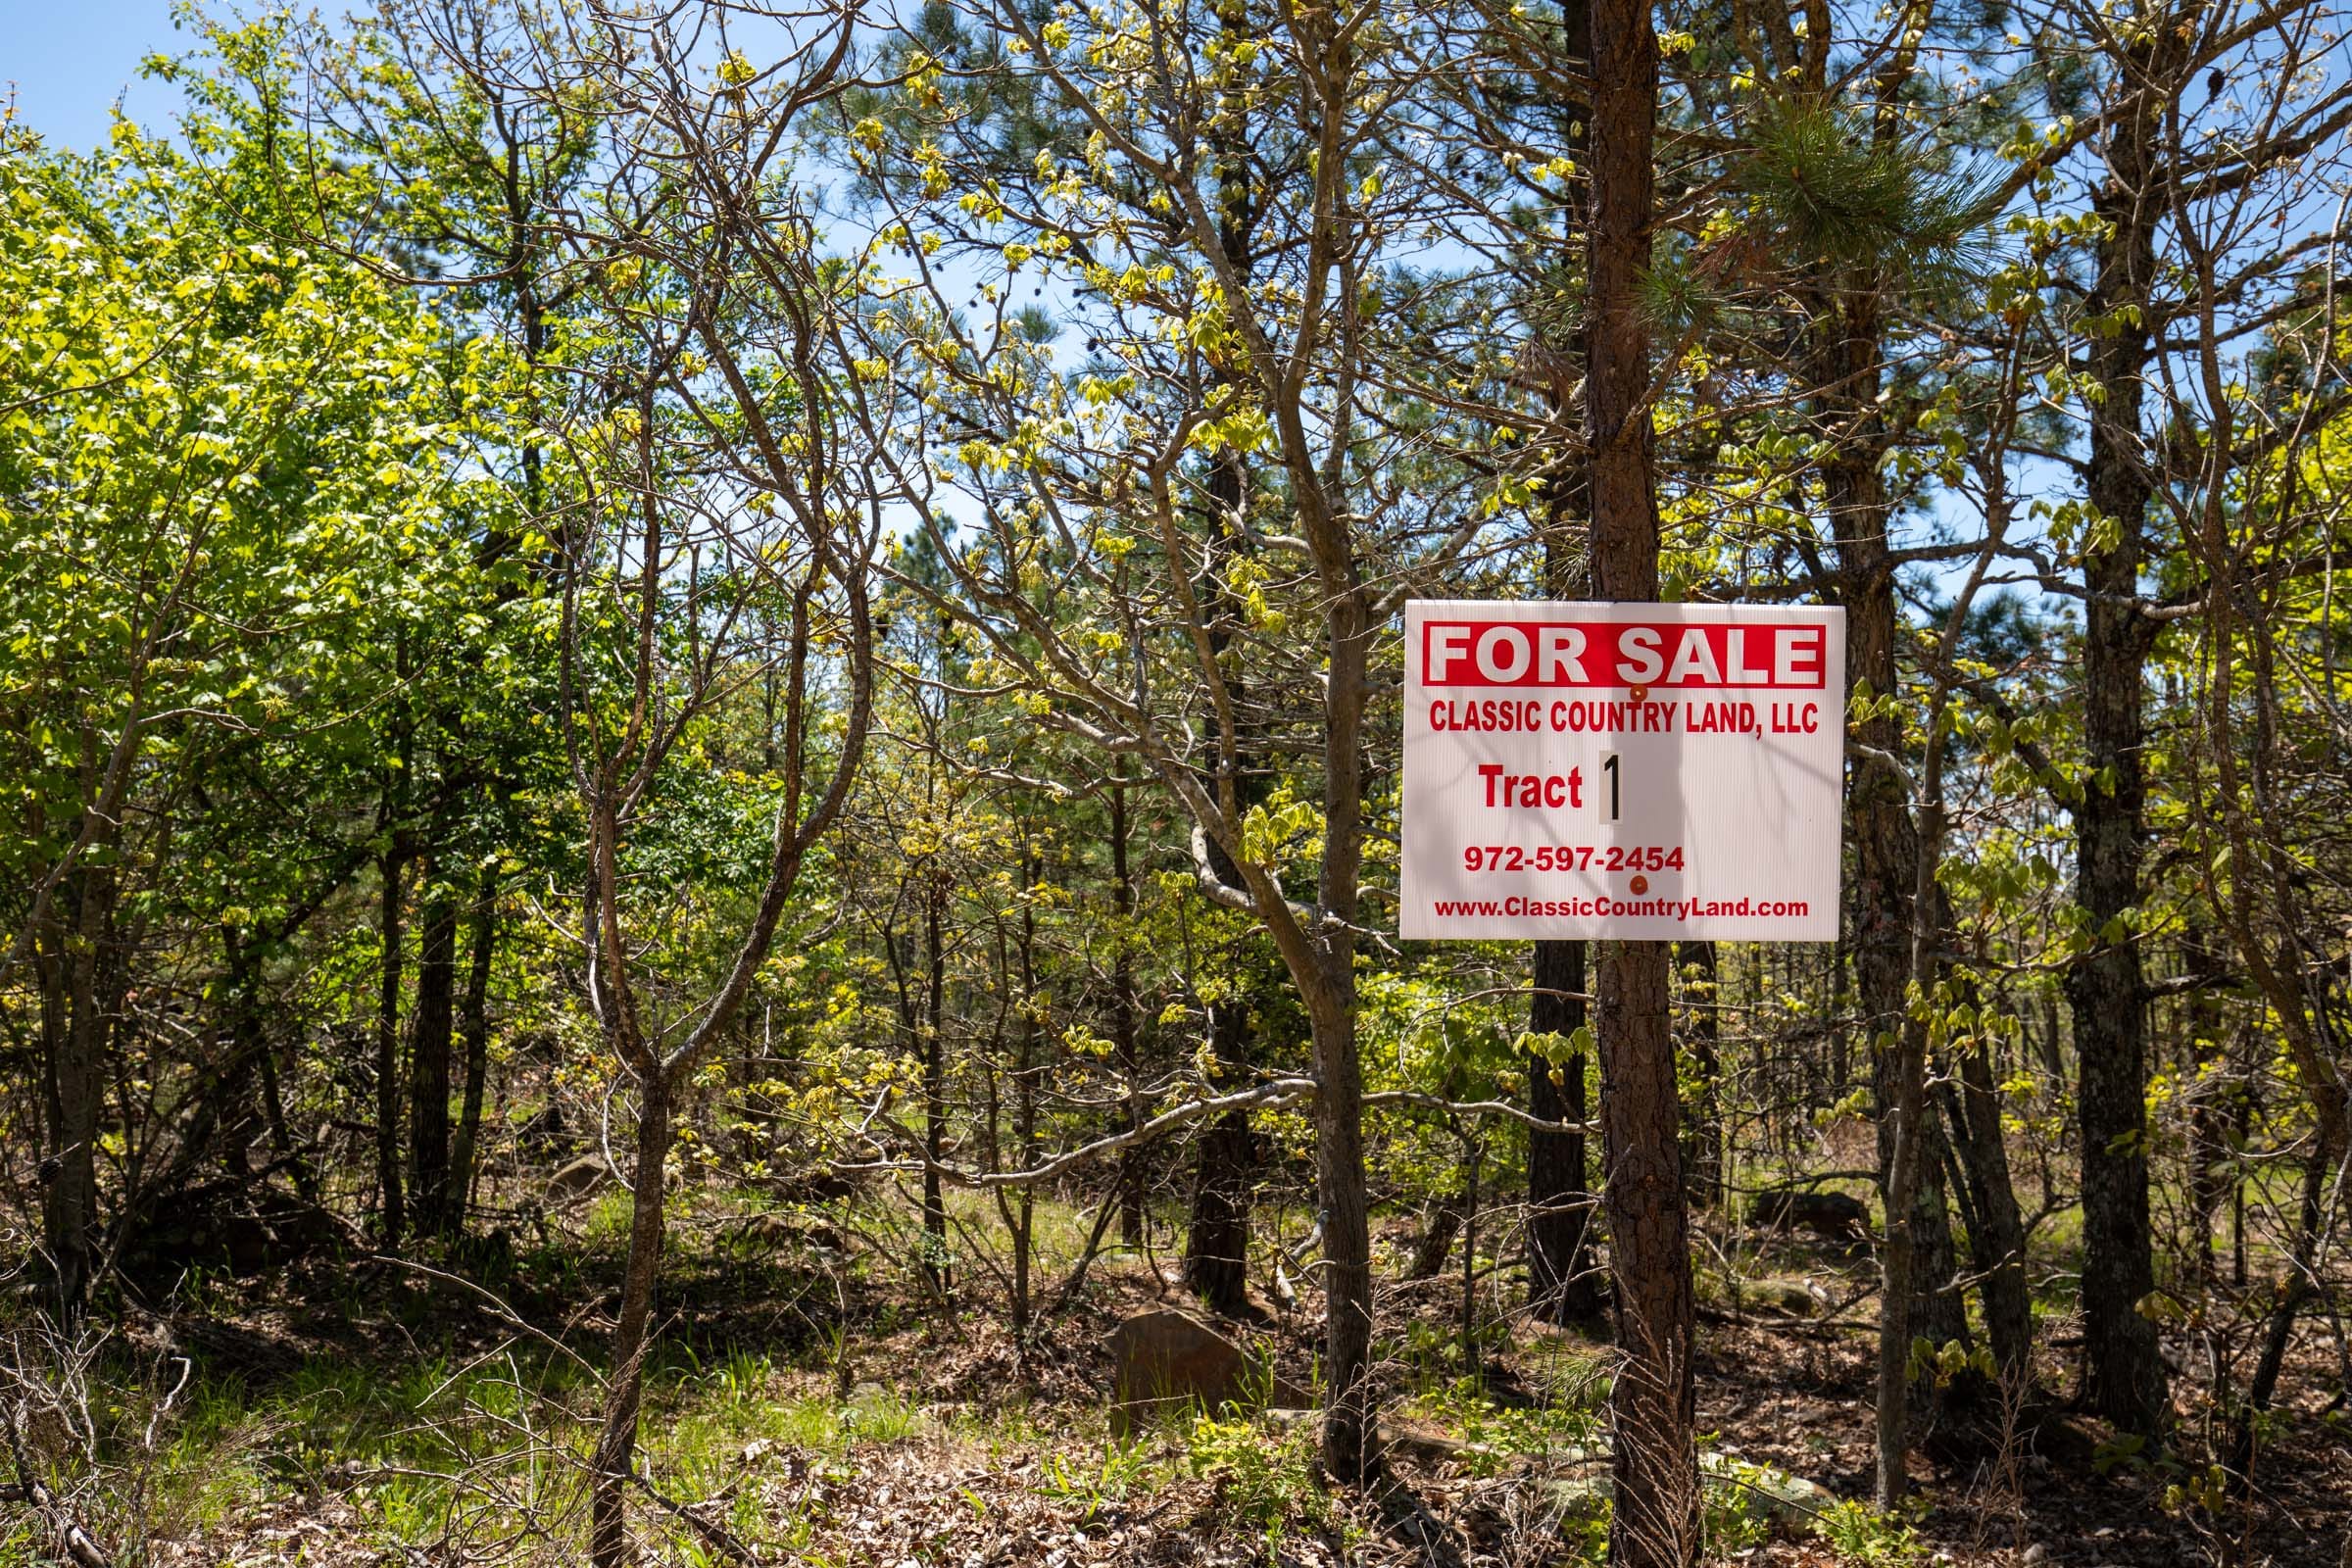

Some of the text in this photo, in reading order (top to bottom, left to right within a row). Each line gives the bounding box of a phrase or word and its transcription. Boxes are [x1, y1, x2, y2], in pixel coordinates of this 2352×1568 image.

[1428, 625, 1821, 685] FOR SALE
[1429, 700, 1819, 740] CLASSIC COUNTRY LAND, LLC
[1478, 754, 1620, 821] Tract 1
[1464, 846, 1685, 872] 972-597-2454
[1434, 896, 1809, 922] www.ClassicCountryLand.com
